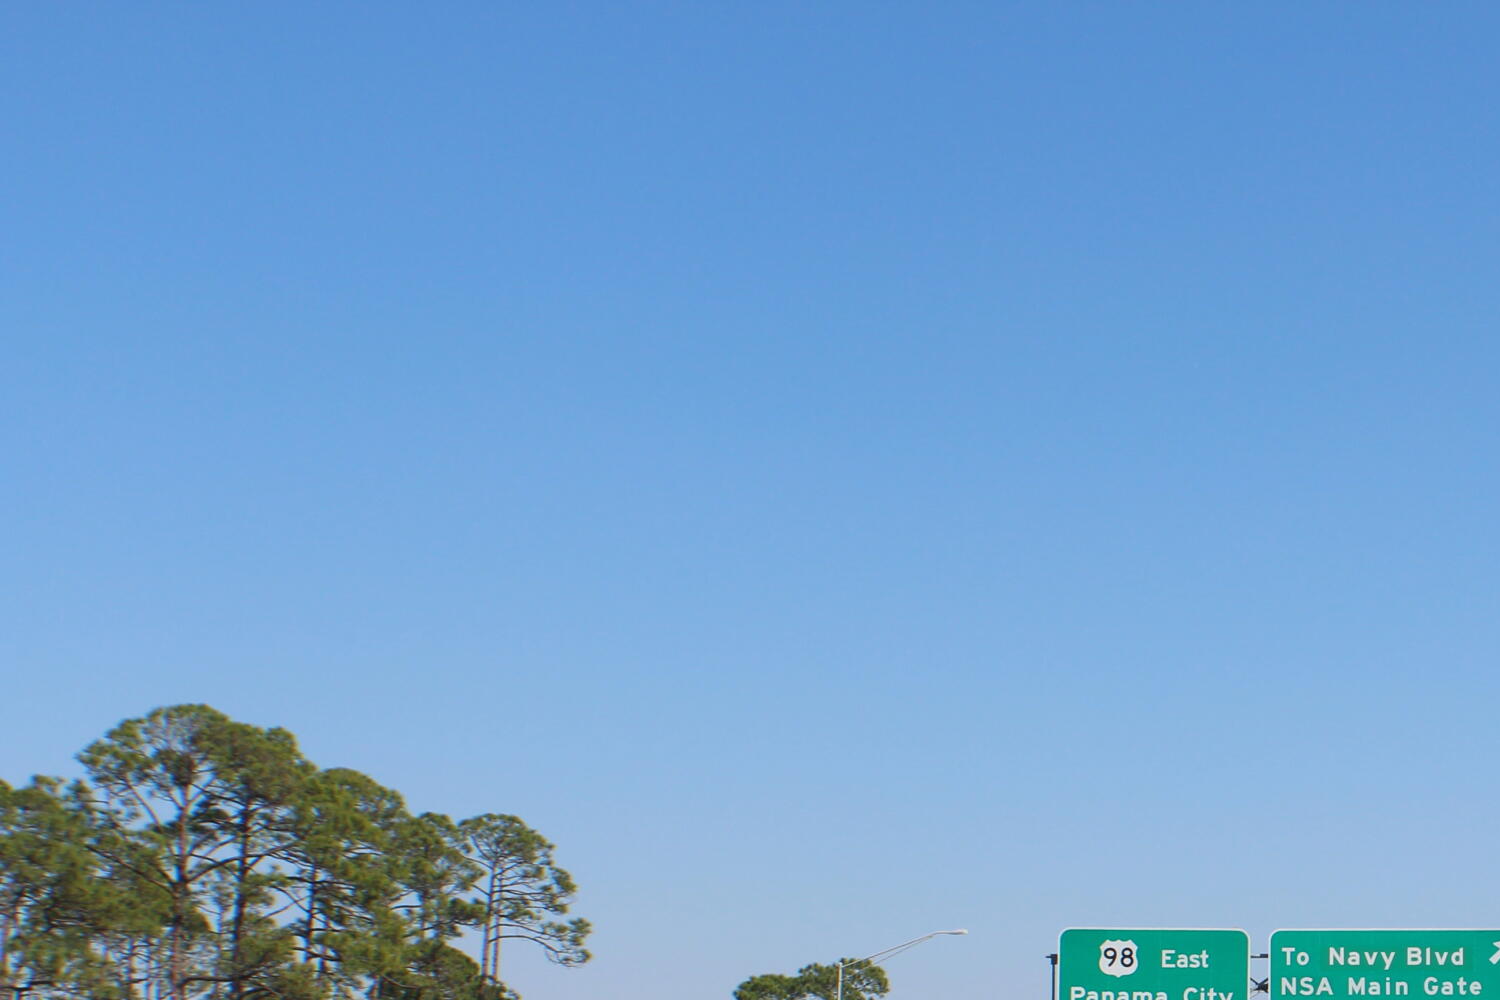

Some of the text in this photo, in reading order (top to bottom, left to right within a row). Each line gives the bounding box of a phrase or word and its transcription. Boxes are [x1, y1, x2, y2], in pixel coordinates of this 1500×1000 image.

[1103, 947, 1209, 968] 98 East
[1281, 947, 1464, 970] To Navy Blvd
[1281, 977, 1482, 996] NSA Main Gate
